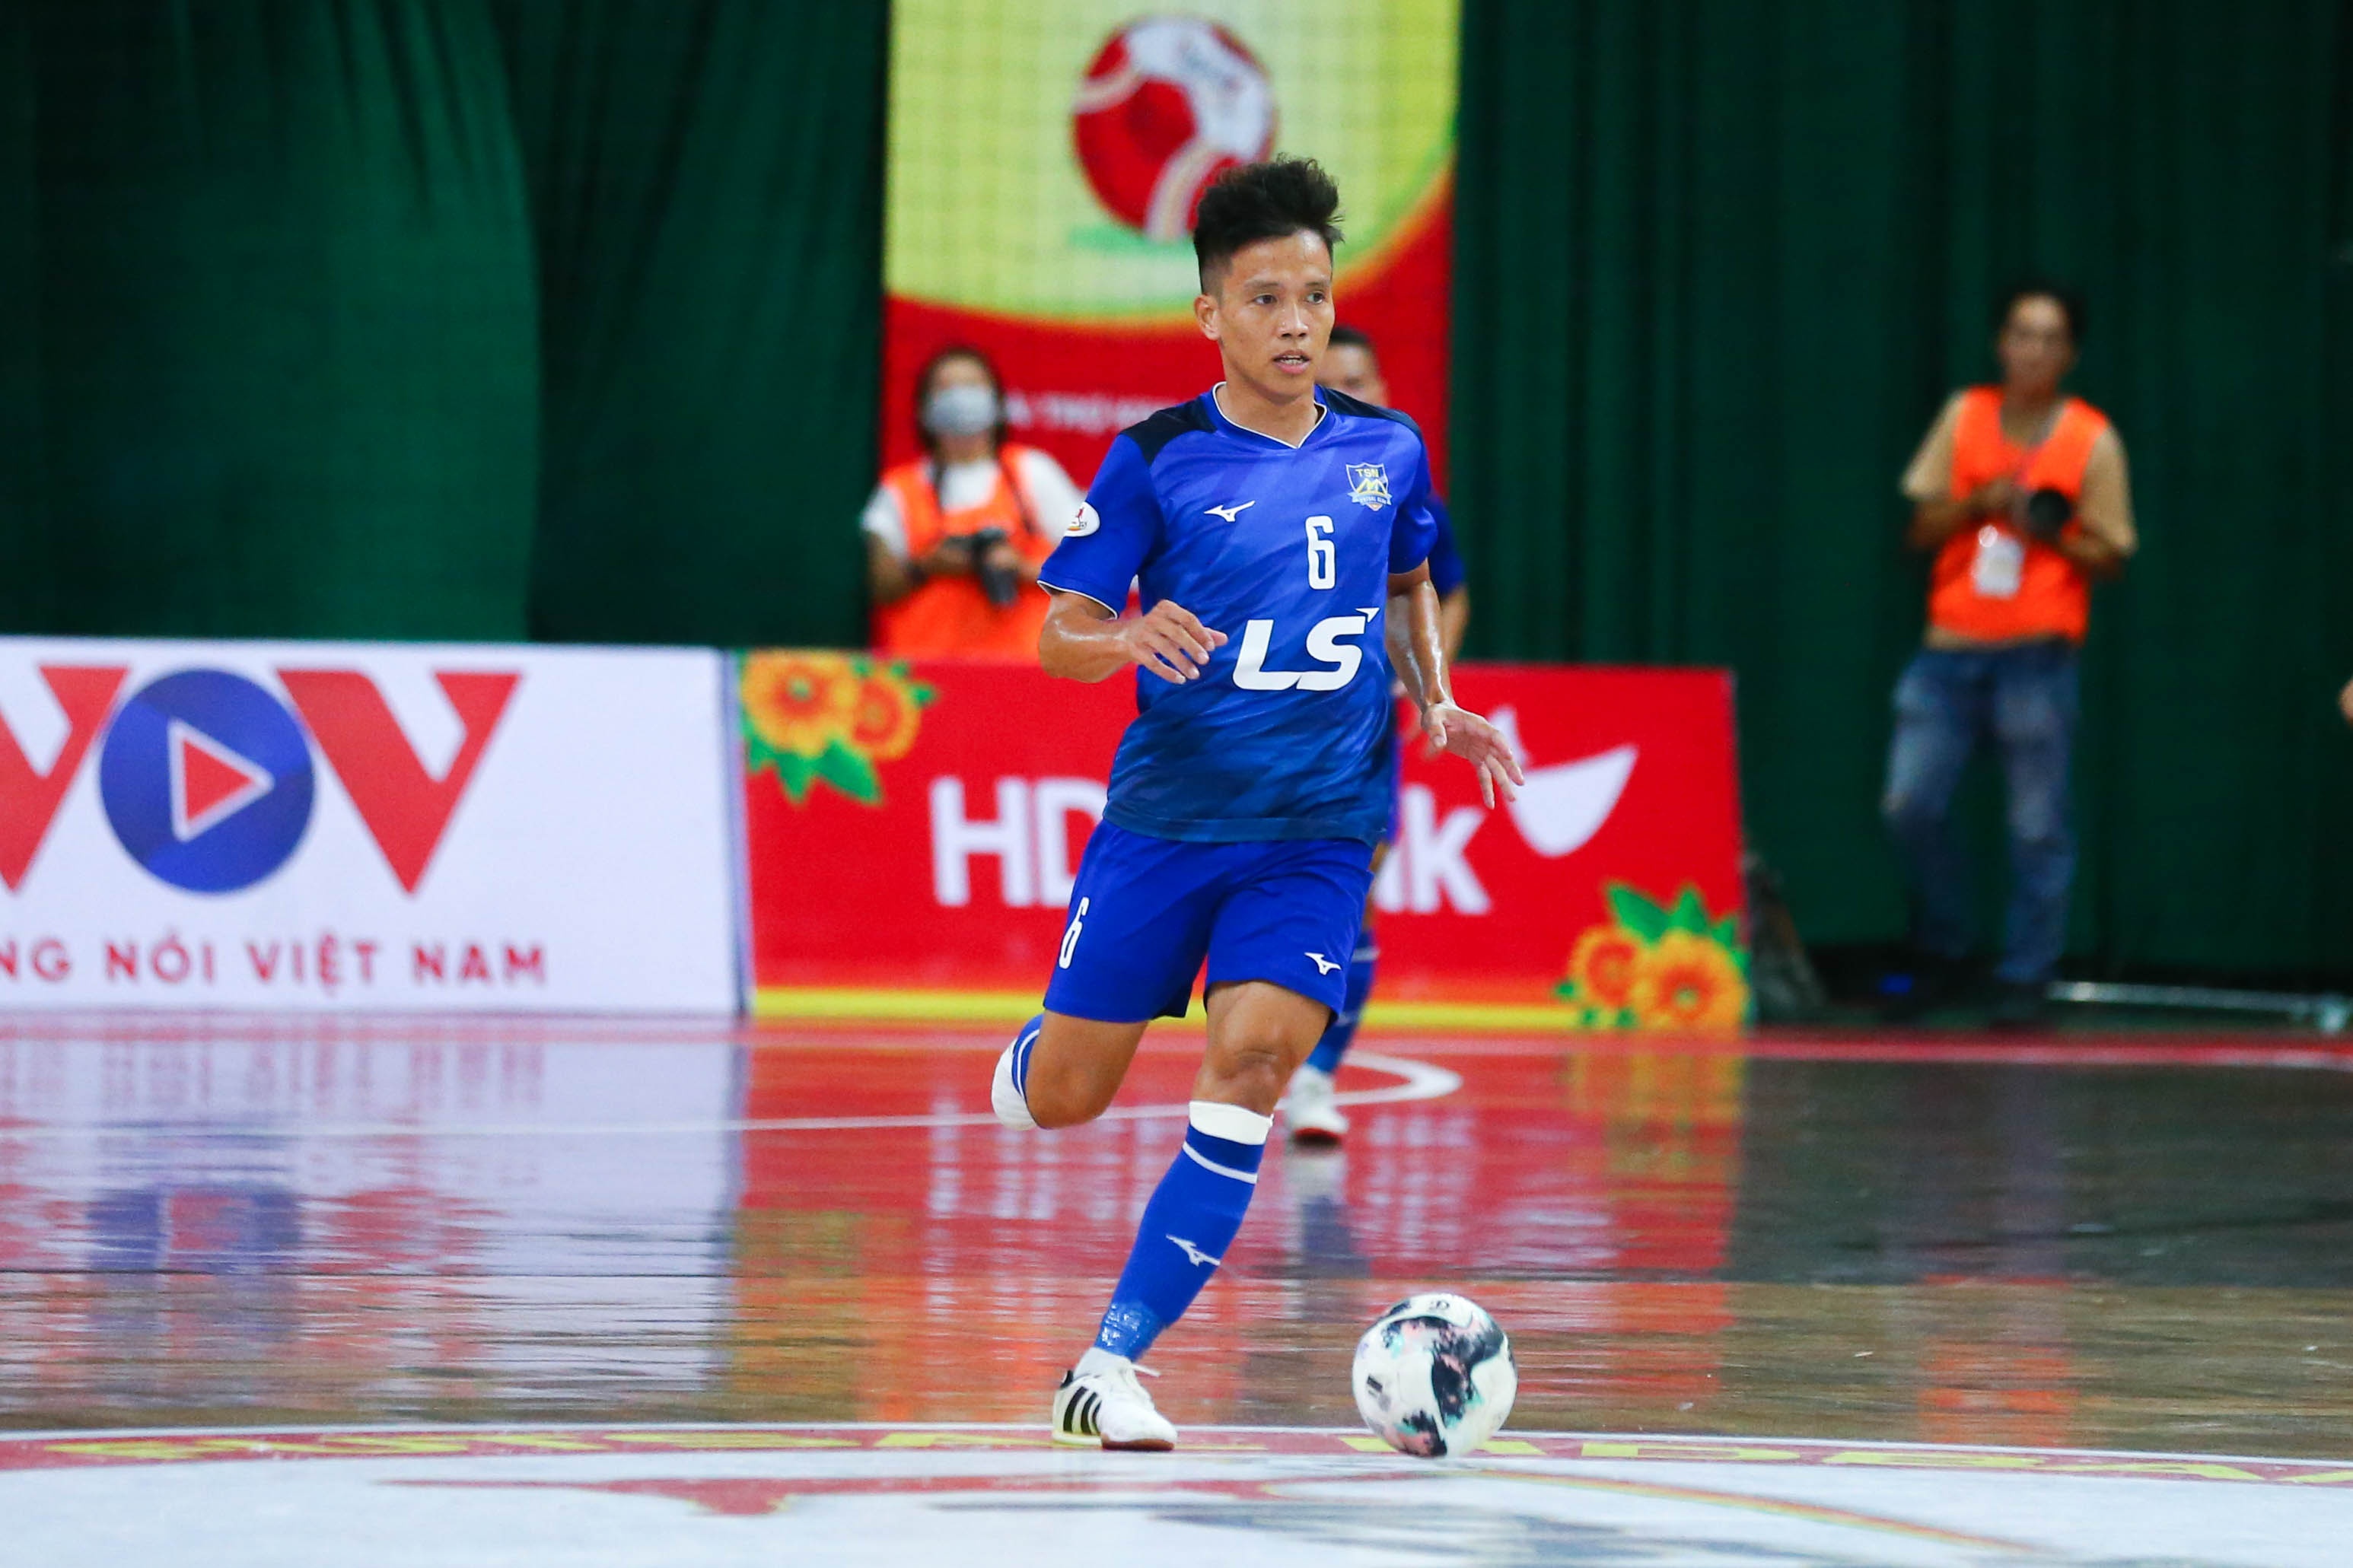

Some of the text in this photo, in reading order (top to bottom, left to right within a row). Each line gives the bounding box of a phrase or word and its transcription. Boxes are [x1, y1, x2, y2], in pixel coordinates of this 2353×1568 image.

[1355, 468, 1380, 479] TSN
[1305, 515, 1336, 590] 6
[1232, 615, 1367, 691] LS
[105, 931, 215, 984] NÓI
[244, 932, 379, 998] VIỆT
[412, 939, 547, 985] NAM
[1059, 896, 1090, 969] 6
